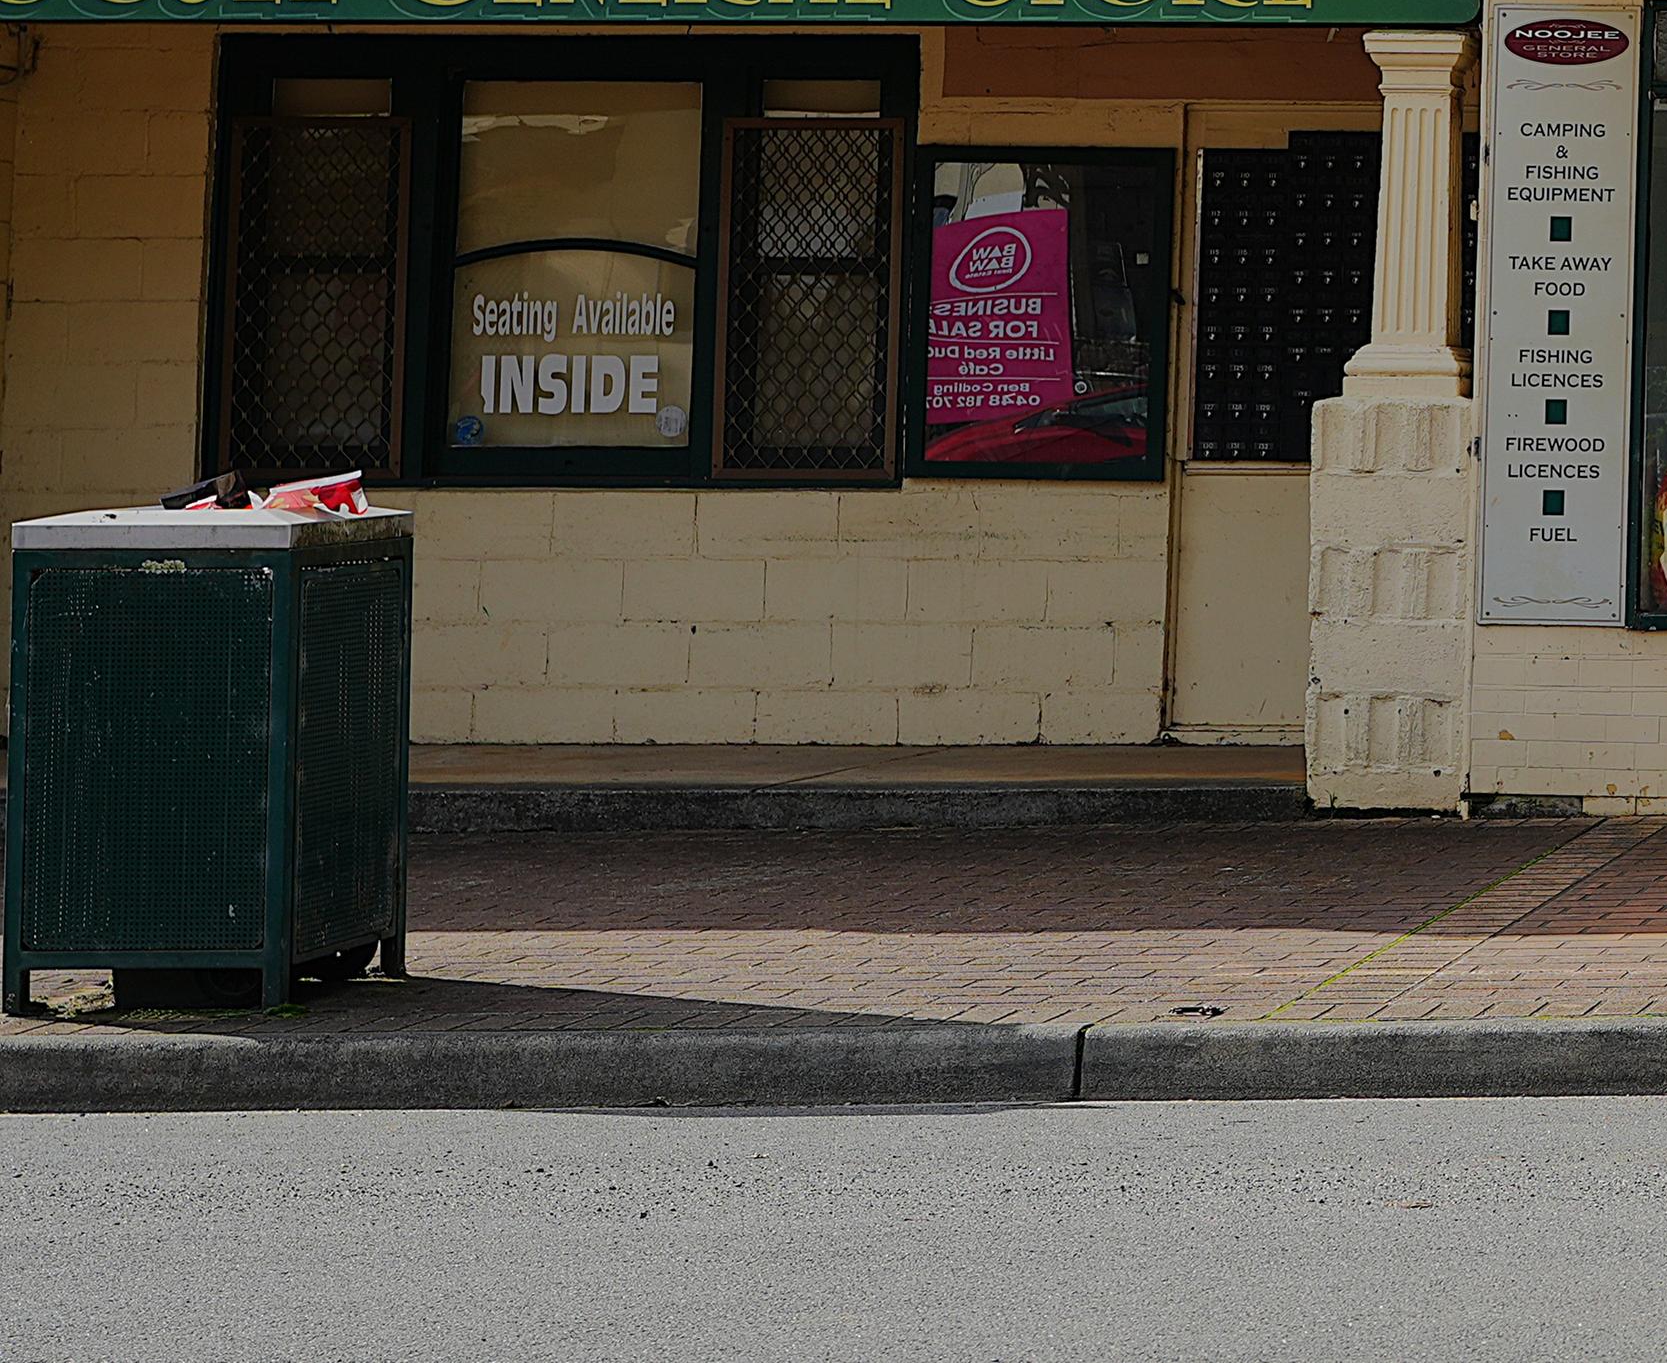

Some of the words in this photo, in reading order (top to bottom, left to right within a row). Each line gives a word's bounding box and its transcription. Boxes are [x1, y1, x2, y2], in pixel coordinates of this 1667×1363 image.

[1515, 30, 1620, 40] NOOJEE
[1523, 44, 1611, 52] GENERAL
[1537, 51, 1597, 59] STORE
[1520, 122, 1606, 137] CAMPING
[1555, 145, 1569, 159] &
[1525, 165, 1599, 180] FISHING
[1507, 187, 1615, 202] EQUIPMENT
[1508, 256, 1556, 271] TAKE
[1560, 256, 1612, 272] AWAY
[1534, 282, 1585, 296] FOOD
[473, 291, 557, 342] Seating
[572, 291, 675, 336] Available
[1518, 349, 1593, 364] FISHING
[481, 354, 658, 415] INSIDE
[1511, 373, 1603, 388] LICENCES
[1505, 437, 1605, 452] FIREWOOD
[1507, 464, 1600, 478] LICENCES
[1529, 528, 1577, 542] FUEL
